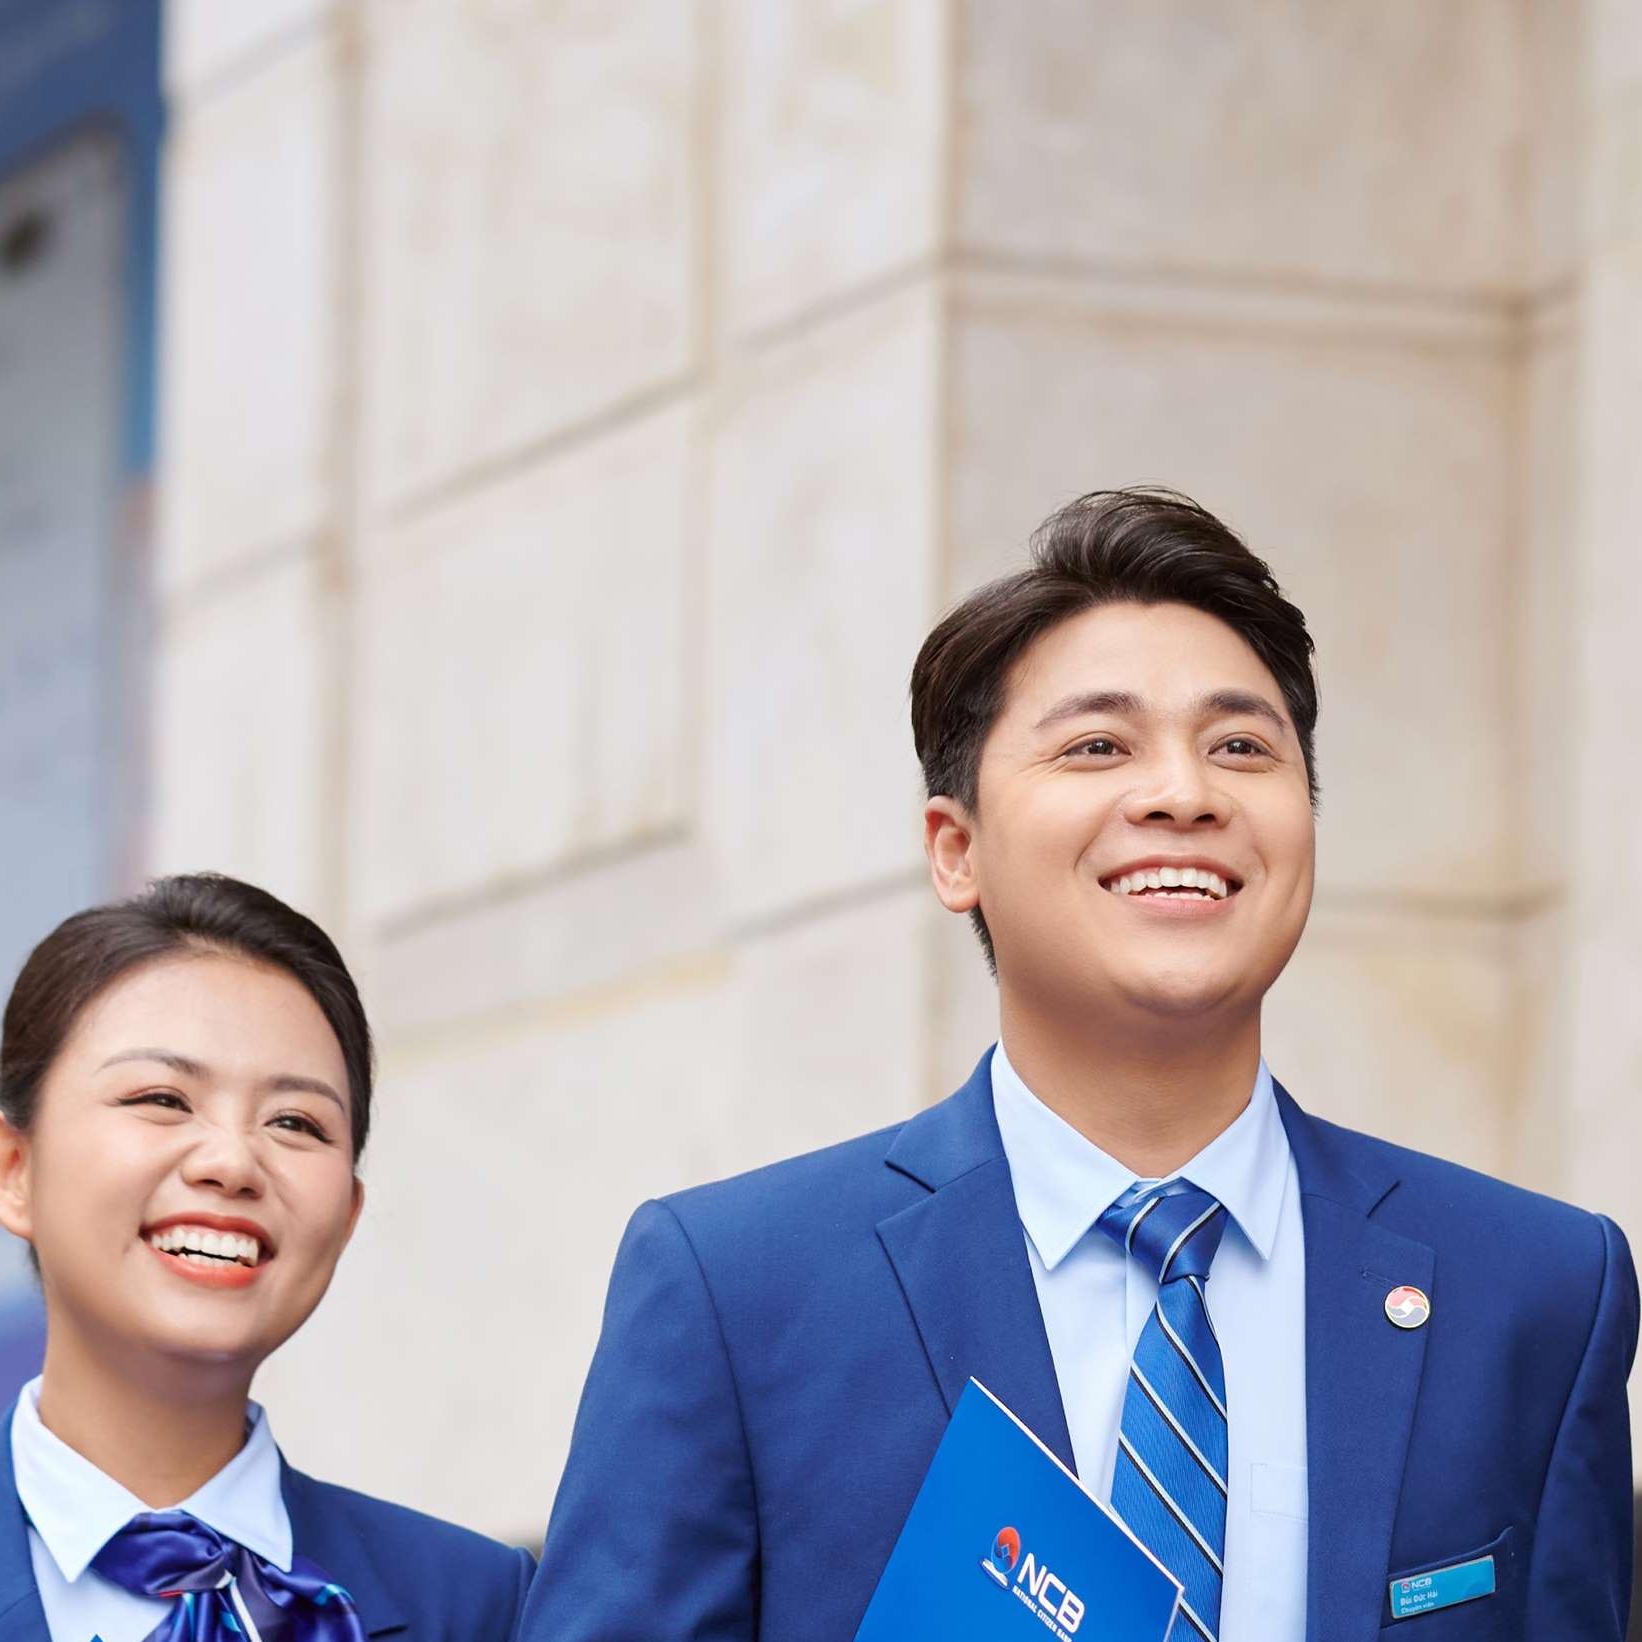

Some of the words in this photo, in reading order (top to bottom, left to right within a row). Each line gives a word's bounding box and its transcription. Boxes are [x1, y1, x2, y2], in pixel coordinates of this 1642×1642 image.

[1017, 1552, 1086, 1634] NCB
[1412, 1577, 1432, 1590] NCB
[1012, 1585, 1038, 1613] NATIONAL
[1037, 1609, 1057, 1632] CITIZEN
